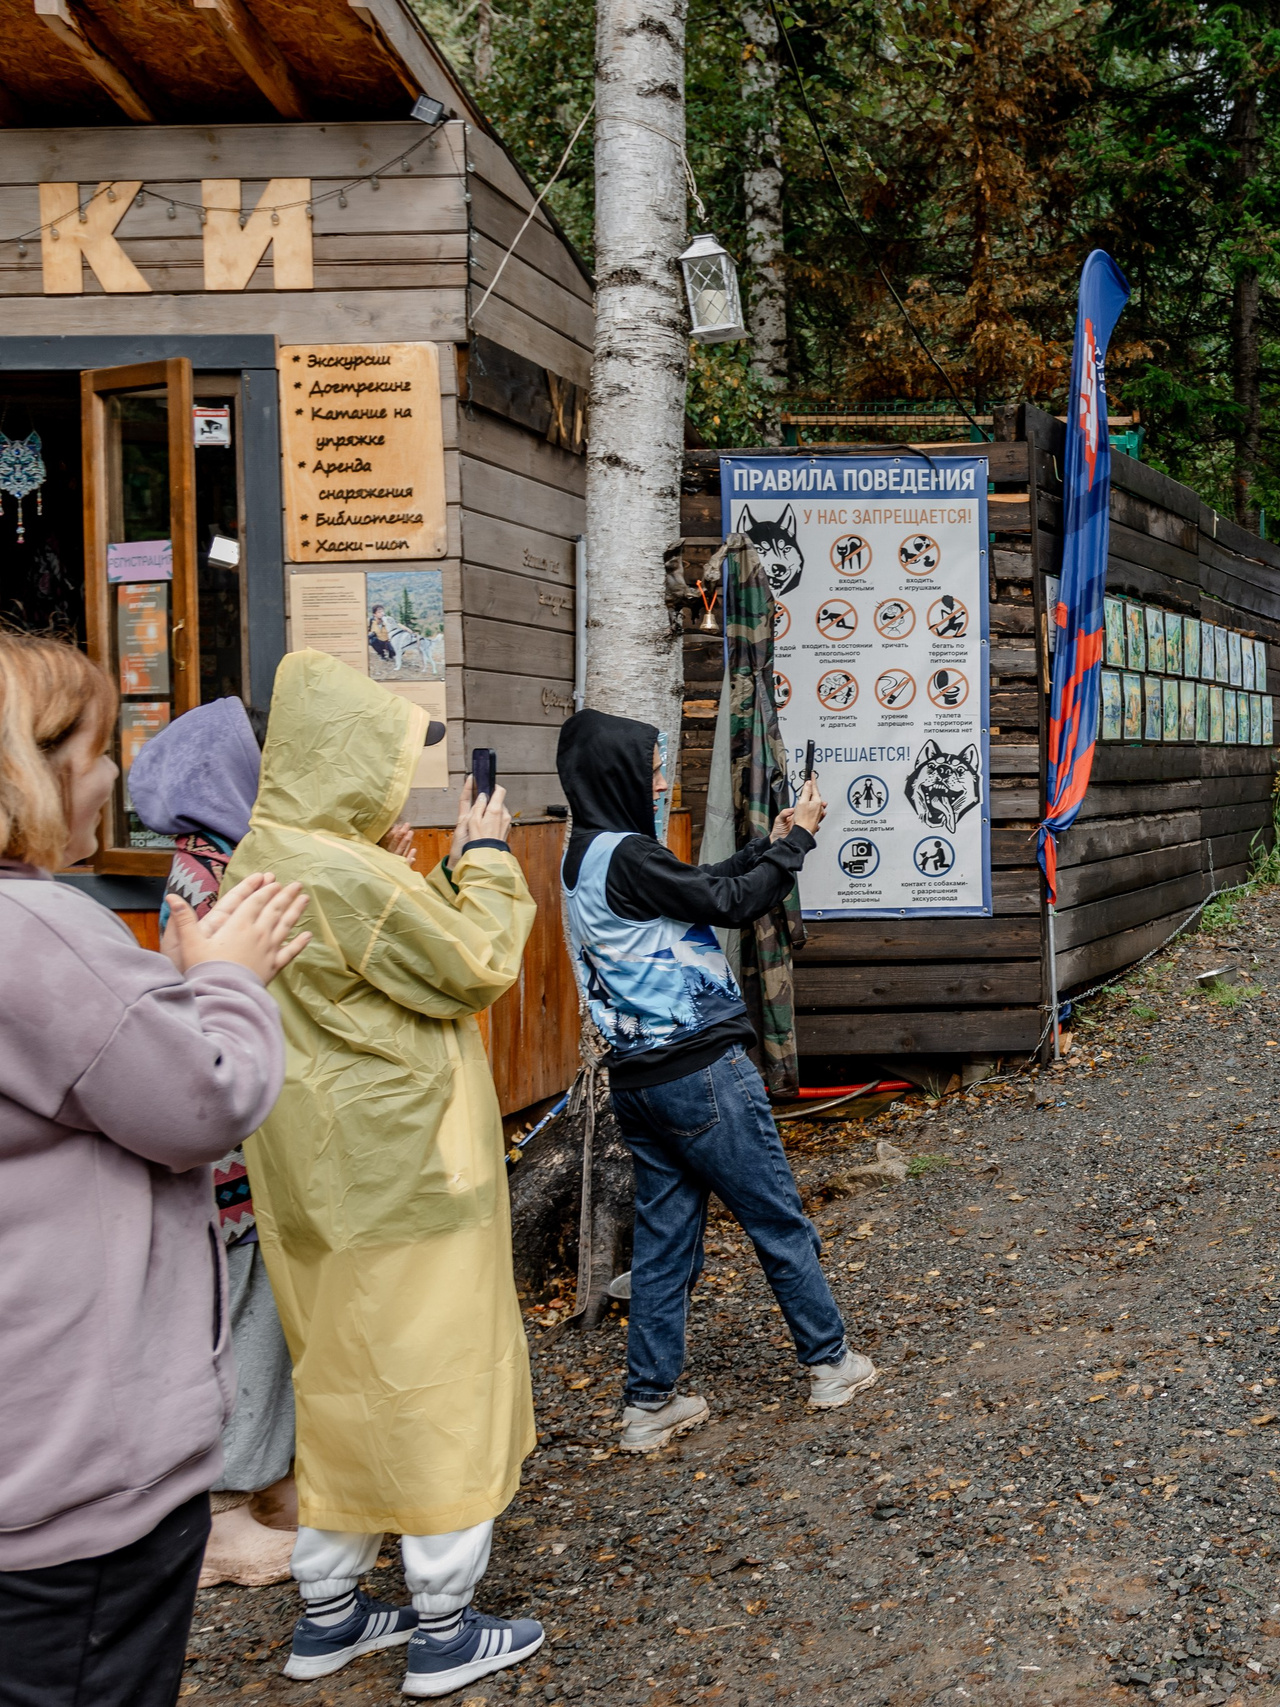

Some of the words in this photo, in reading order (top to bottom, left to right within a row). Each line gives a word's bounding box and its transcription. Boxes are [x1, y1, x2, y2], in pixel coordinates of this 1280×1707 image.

[307, 354, 391, 371] Экскурсии
[309, 380, 411, 398] Догтрекинг
[311, 407, 388, 420] Катание
[394, 407, 412, 418] на
[316, 435, 385, 451] упряжке
[312, 458, 372, 478] Аренда
[733, 468, 838, 492] ПРАВИЛА
[843, 468, 975, 494] ПОВЕДЕНИЯ
[318, 487, 413, 504] снаряжения
[803, 509, 813, 525] У
[818, 509, 848, 525] НАС
[852, 507, 972, 527] ЗАПРЕЩАЕТСЯ!
[315, 539, 409, 553] Хаски-шоп
[779, 644, 797, 652] едой
[928, 650, 968, 658] территории
[931, 642, 955, 650] бегать
[795, 747, 910, 763] РЗРЕШАЕТСЯ!
